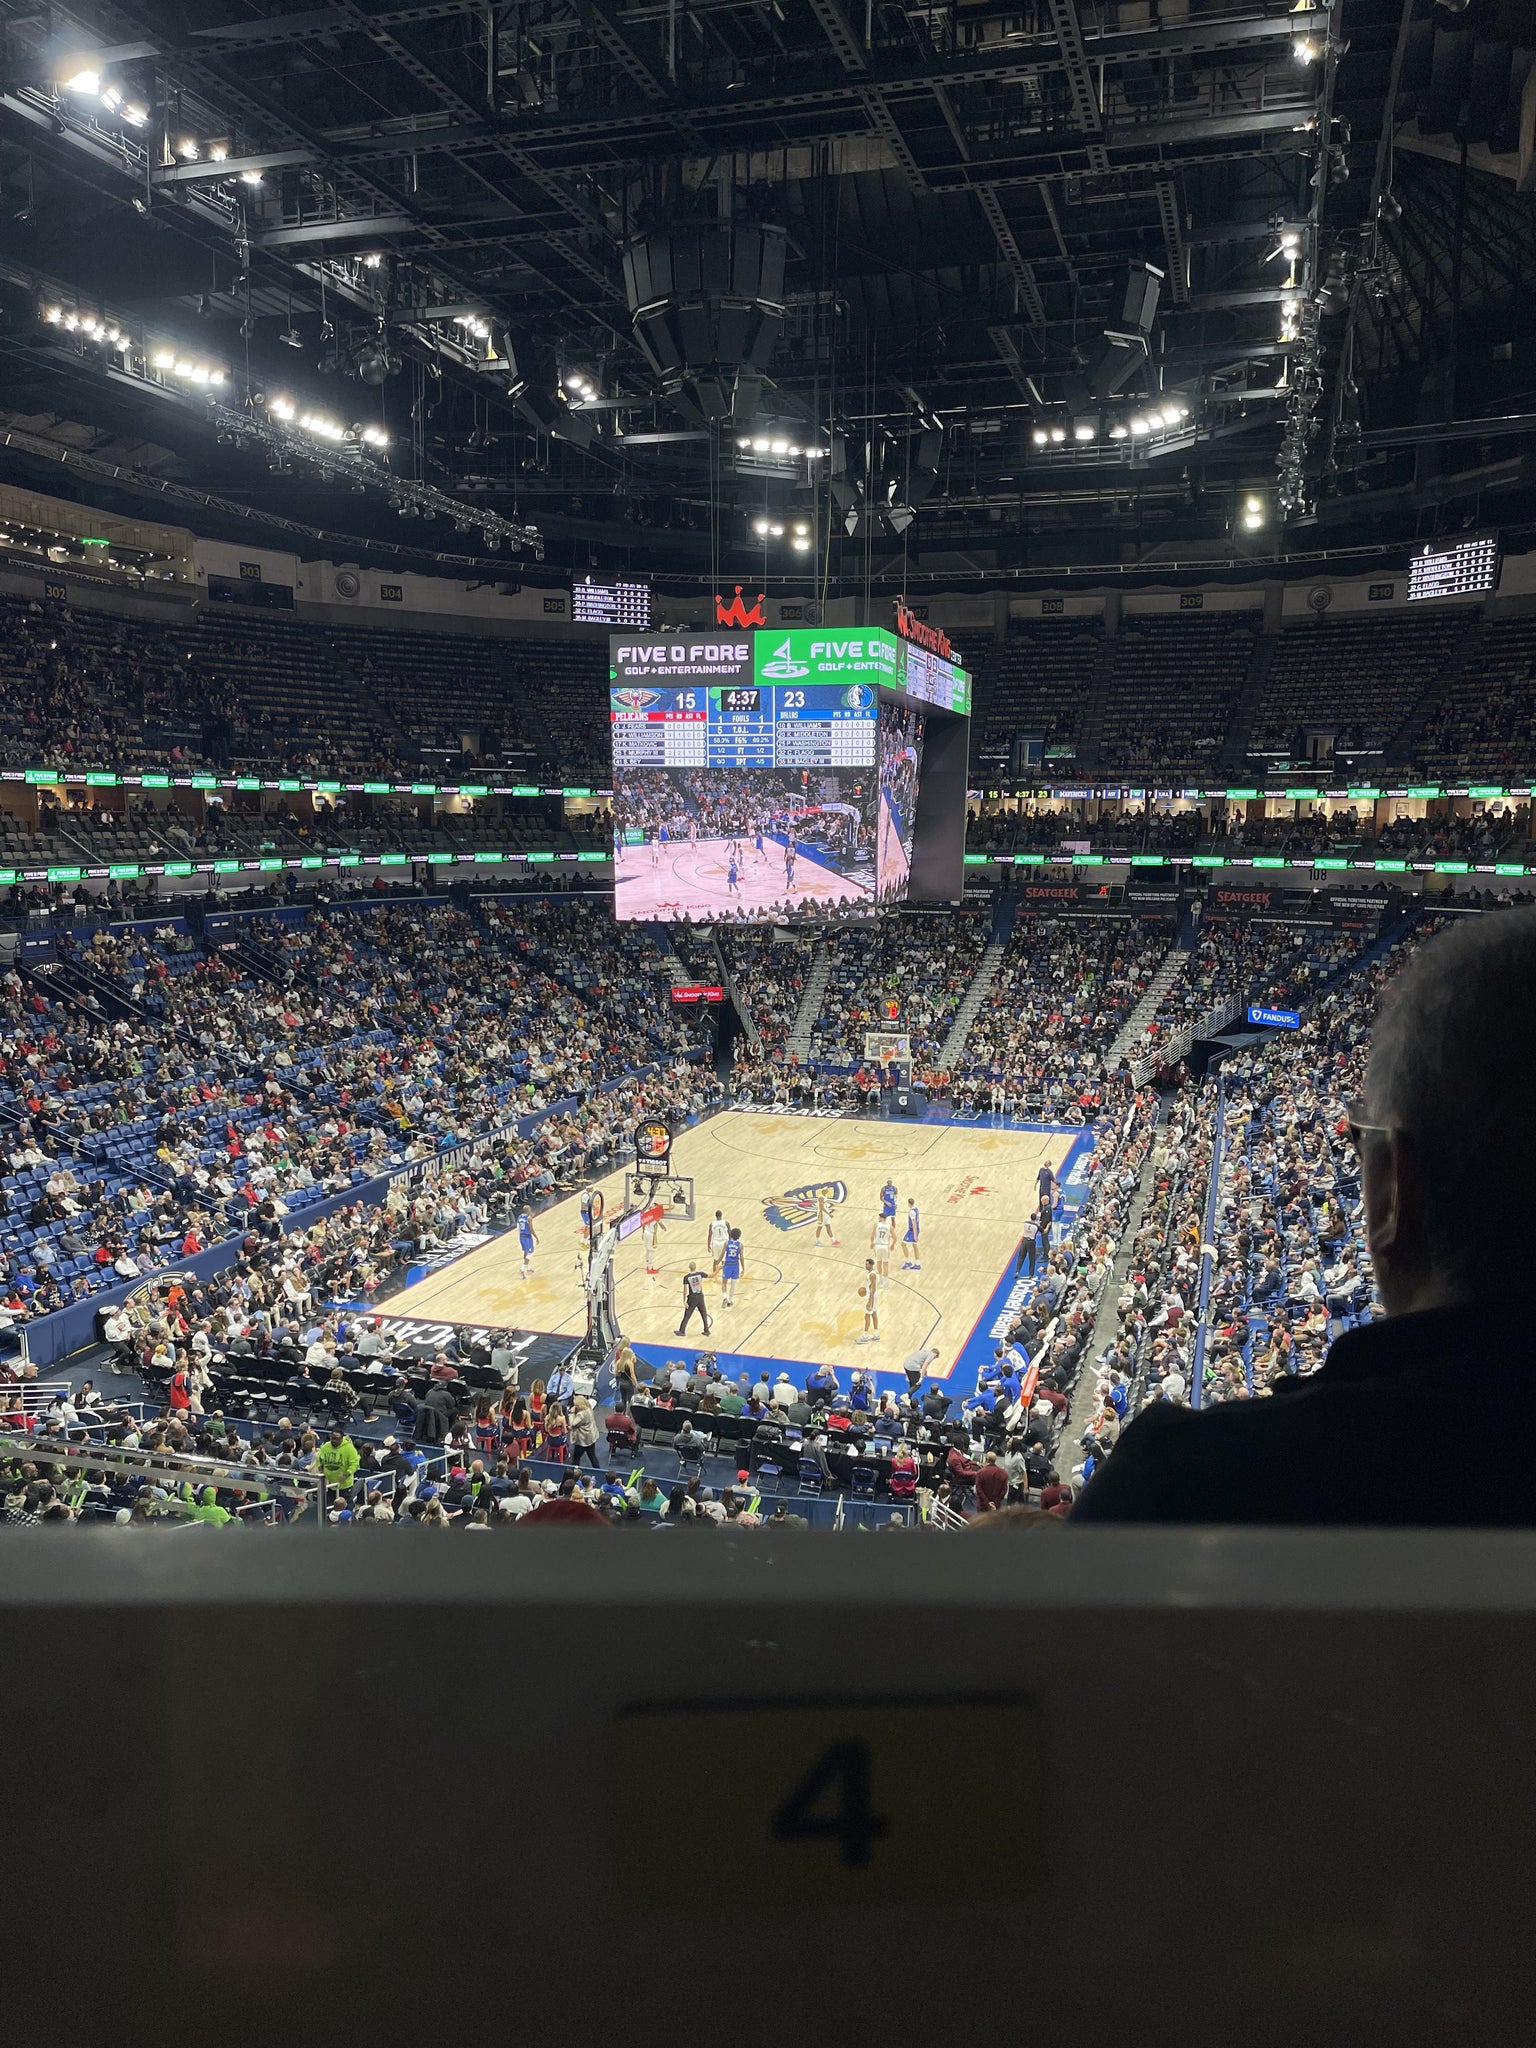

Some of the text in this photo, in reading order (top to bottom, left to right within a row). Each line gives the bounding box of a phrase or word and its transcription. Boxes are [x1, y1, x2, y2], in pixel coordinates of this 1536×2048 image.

[241, 565, 260, 578] 303
[46, 584, 66, 600] 302
[381, 587, 402, 598] 304
[1370, 587, 1392, 598] 310
[544, 600, 564, 611] 305
[1042, 601, 1063, 612] 308
[1181, 596, 1203, 607] 309
[782, 608, 801, 618] 306
[618, 645, 748, 663] FIVE O FORE
[811, 642, 863, 658] FIVE
[676, 693, 695, 709] 15
[728, 691, 758, 704] 4:37
[784, 691, 805, 707] 23
[615, 713, 648, 721] PELICANS
[337, 866, 352, 878] 103
[520, 862, 536, 874] 104
[1308, 868, 1327, 881] 108
[1025, 887, 1079, 899] SEATGEEK
[1217, 891, 1271, 904] SEATGEEK
[647, 1127, 666, 1136] 4:37
[728, 1248, 737, 1257] 35
[591, 1317, 599, 1347] NBA
[772, 1736, 891, 1870] 4
